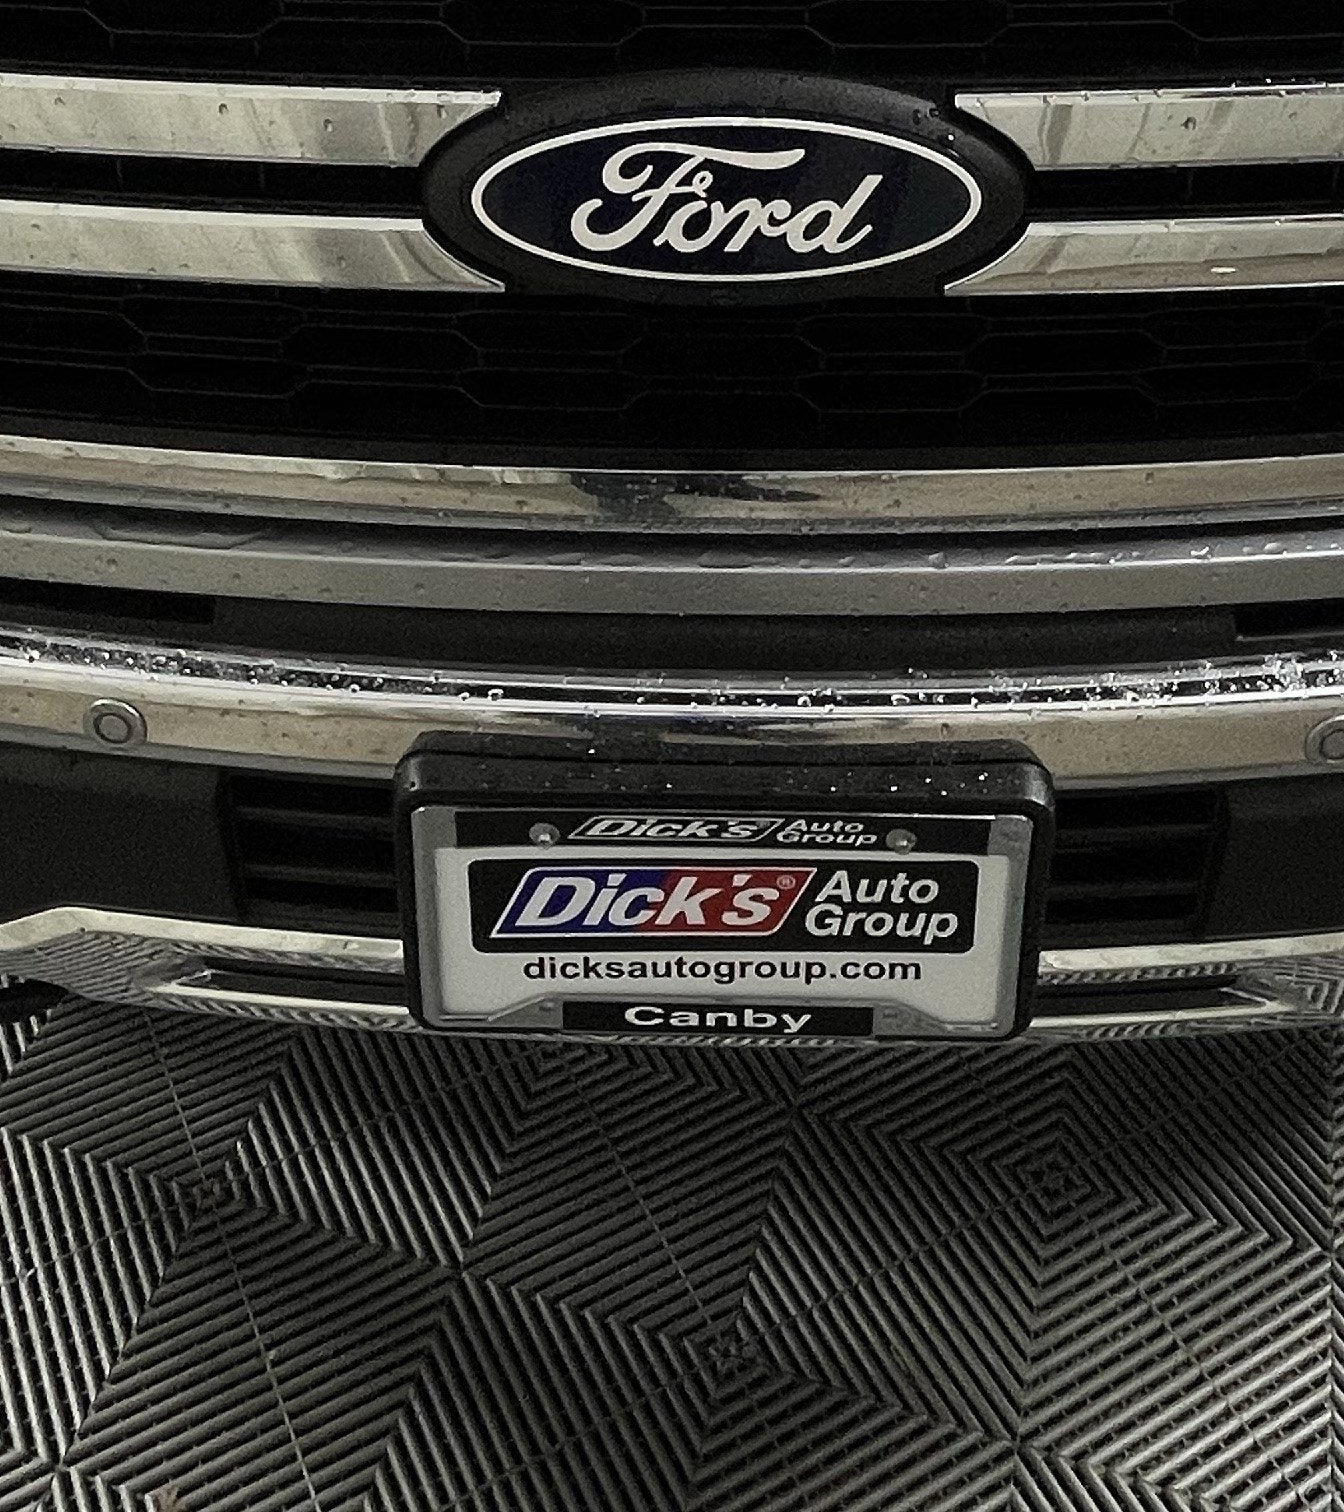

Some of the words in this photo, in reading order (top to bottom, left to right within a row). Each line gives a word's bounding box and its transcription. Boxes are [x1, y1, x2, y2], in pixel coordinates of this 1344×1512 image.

[571, 143, 883, 254] Ford
[585, 820, 758, 838] Dick's
[776, 830, 878, 846] Group
[789, 819, 864, 832] Auto
[515, 874, 779, 926] Dick's
[816, 870, 939, 904] Auto
[805, 903, 958, 945] Group
[523, 956, 922, 983] dicksautogroup.com
[624, 1007, 812, 1034] Canby
